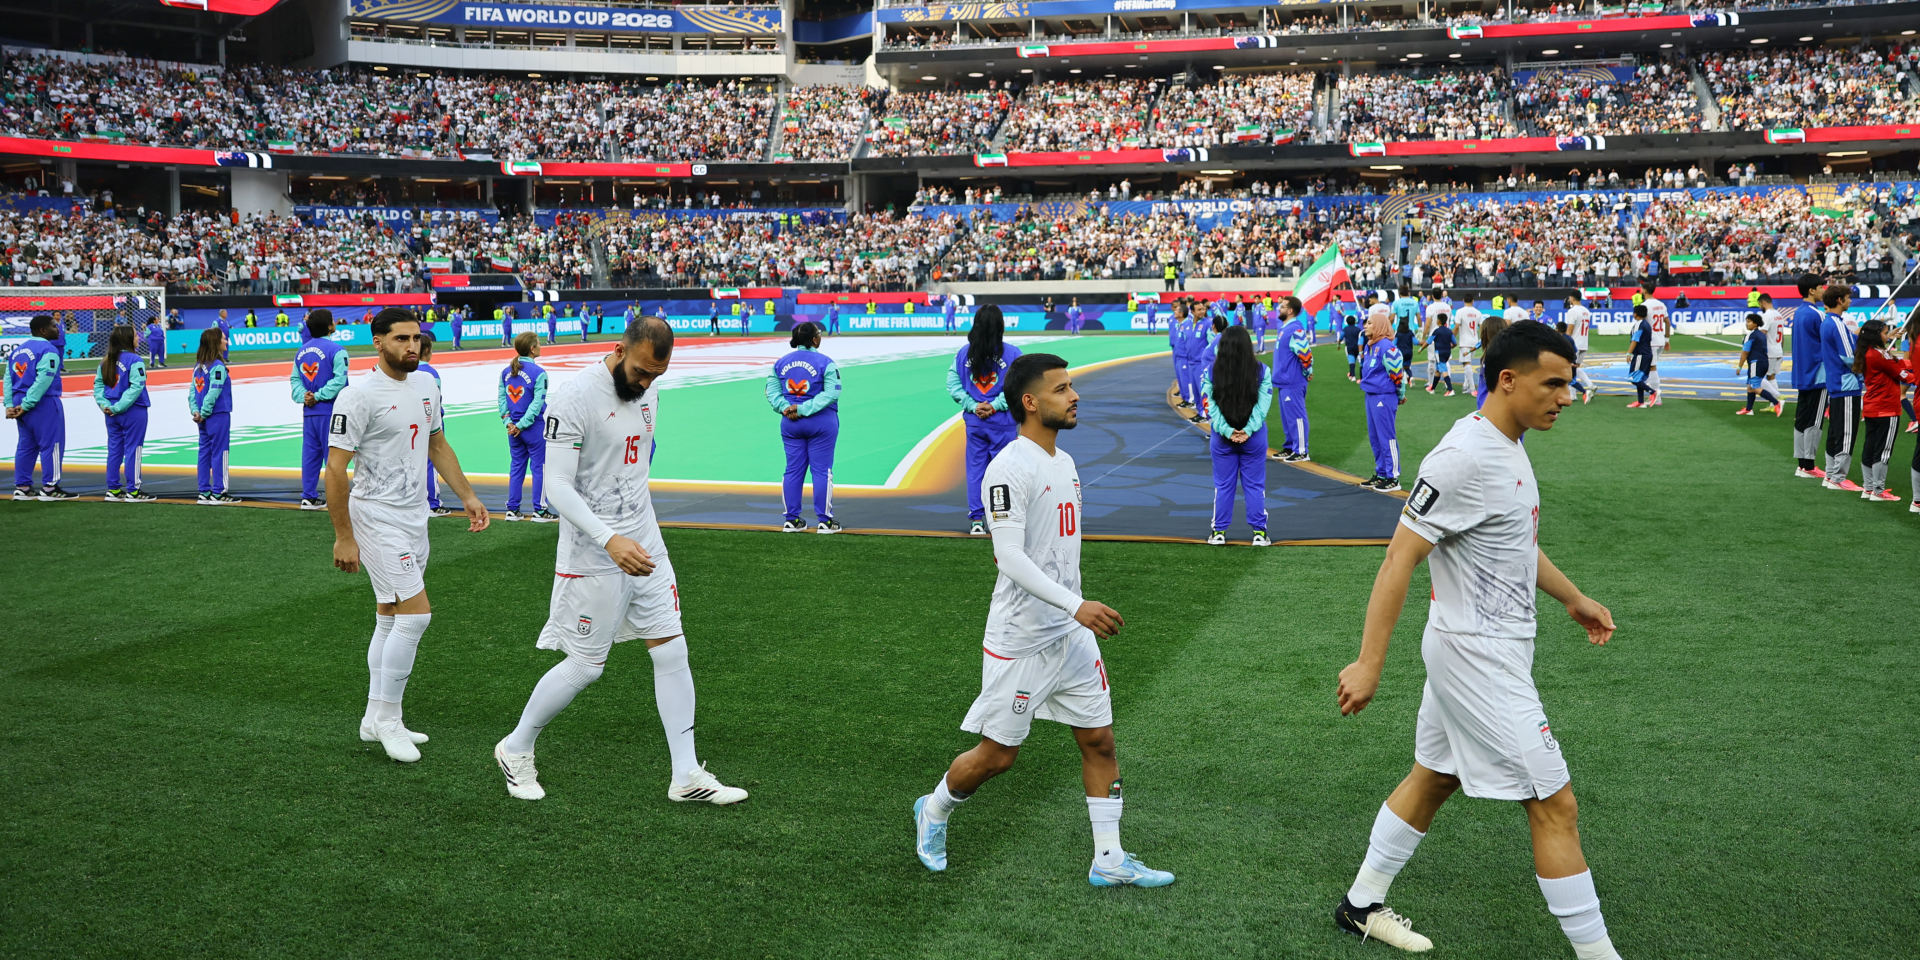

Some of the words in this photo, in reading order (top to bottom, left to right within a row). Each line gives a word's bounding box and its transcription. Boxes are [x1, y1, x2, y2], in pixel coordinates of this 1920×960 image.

[1114, 0, 1176, 10] #FIFAWorldCup
[465, 7, 504, 21] FIFA
[506, 9, 571, 24] WORLD
[573, 11, 609, 25] CUP
[611, 13, 673, 28] 2026
[1599, 191, 1684, 203] AELES
[666, 319, 690, 329] RLD
[691, 319, 711, 328] CUP
[713, 319, 746, 328] 202
[849, 317, 872, 328] PLAY
[873, 317, 890, 328] THE
[890, 317, 910, 328] FIFA
[910, 316, 944, 328] WORLD
[1652, 314, 1664, 332] 20
[1671, 311, 1692, 325] OF
[1695, 311, 1757, 324] AMERIC
[462, 324, 481, 336] PLAY
[481, 324, 495, 335] THE
[511, 322, 536, 334] WORLD
[1469, 321, 1476, 337] 4
[1581, 319, 1590, 336] 17
[233, 332, 281, 345] WORLD
[283, 331, 301, 344] CU
[330, 330, 351, 341] 26
[296, 347, 326, 361] VOLUNTEER
[505, 370, 532, 385] VONTEER
[781, 361, 818, 378] VOLUNTEER
[409, 424, 418, 450] 7
[624, 435, 641, 465] 15
[1057, 502, 1076, 537] 10
[1531, 505, 1539, 547] 1
[670, 584, 679, 612] 1
